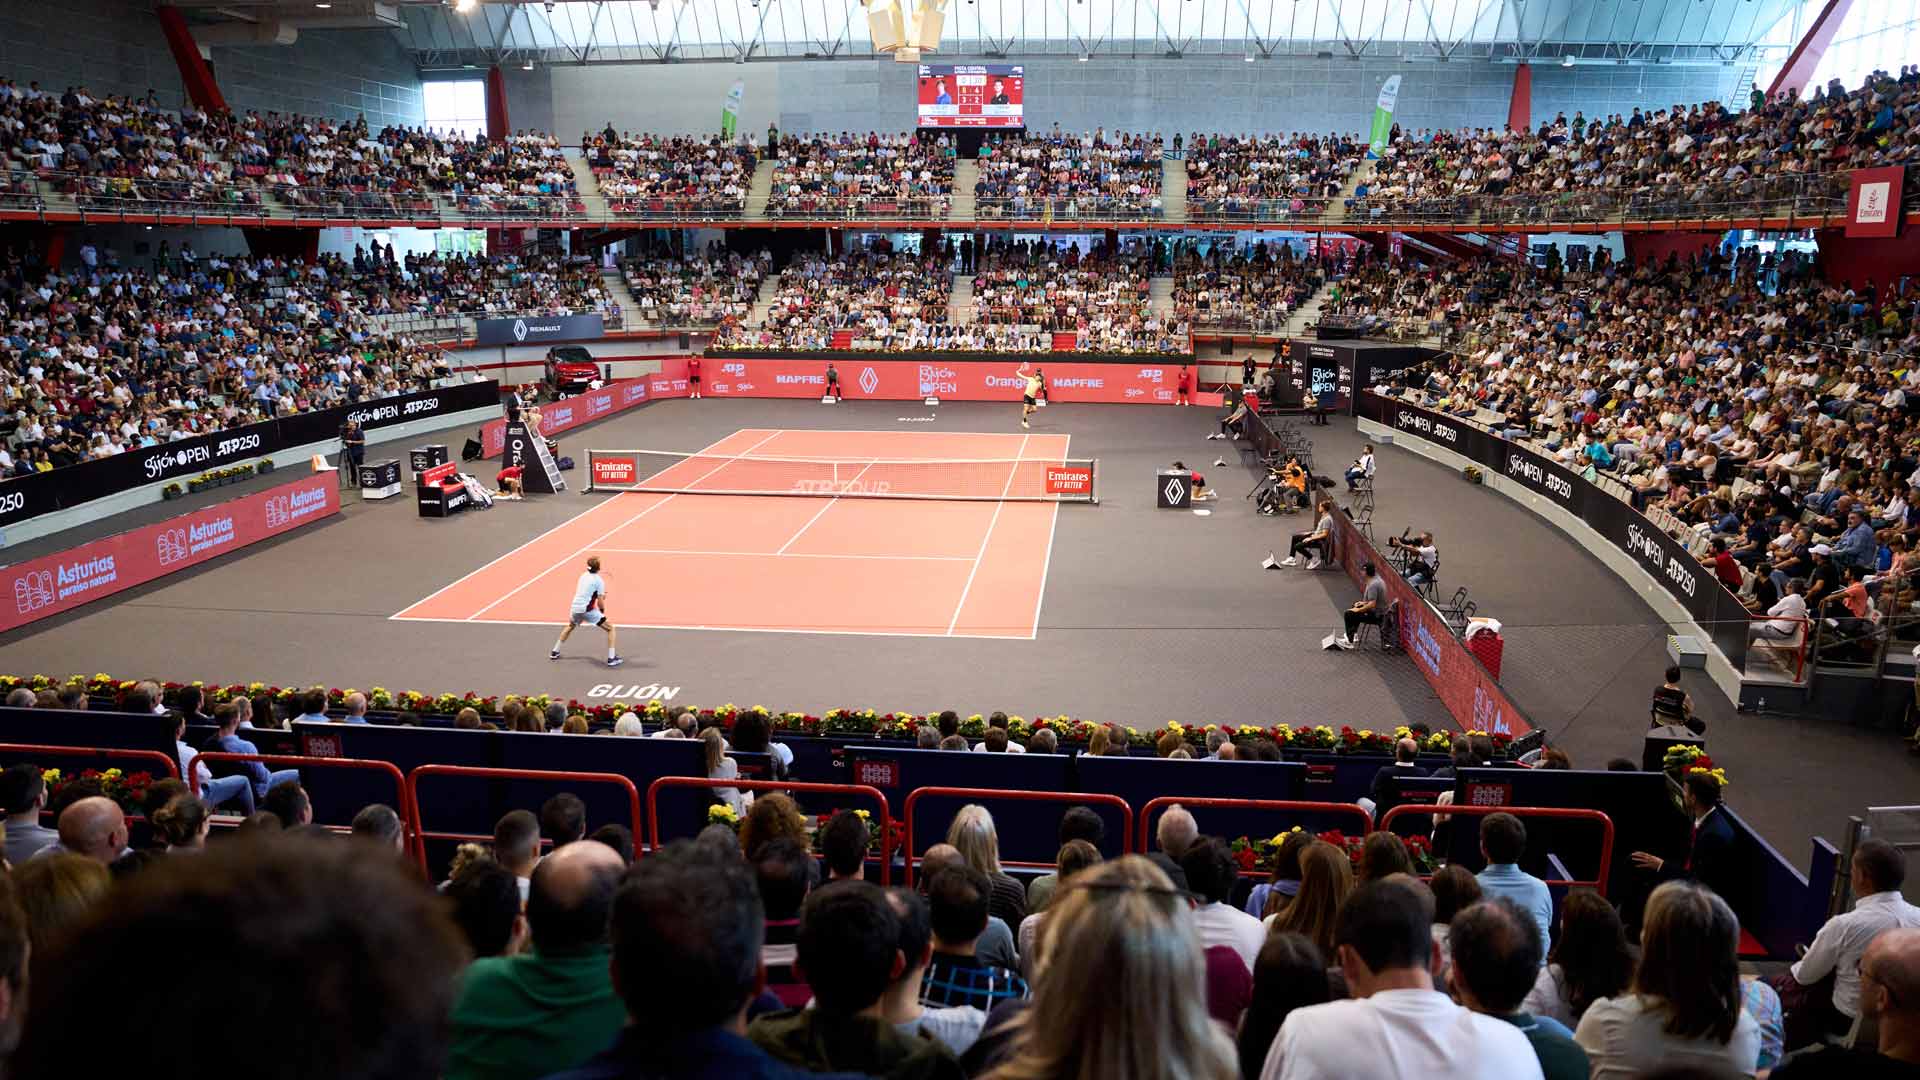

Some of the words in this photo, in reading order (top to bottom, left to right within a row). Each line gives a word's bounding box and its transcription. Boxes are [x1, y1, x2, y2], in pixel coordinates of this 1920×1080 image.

[776, 375, 825, 384] MAPFRE
[1053, 378, 1104, 388] MAPFRE
[373, 405, 399, 421] OPEN
[1415, 416, 1431, 433] OPEN
[176, 445, 210, 466] OPEN
[595, 462, 632, 471] Emirates
[601, 471, 611, 479] FLY
[1524, 461, 1543, 484] OPEN
[1048, 471, 1089, 481] Emirates
[290, 488, 325, 509] Asturias
[189, 517, 233, 544] Asturias
[1644, 537, 1664, 568] OPEN
[58, 555, 114, 587] Asturias
[89, 569, 117, 589] natural
[587, 683, 680, 700] GIJÓN
